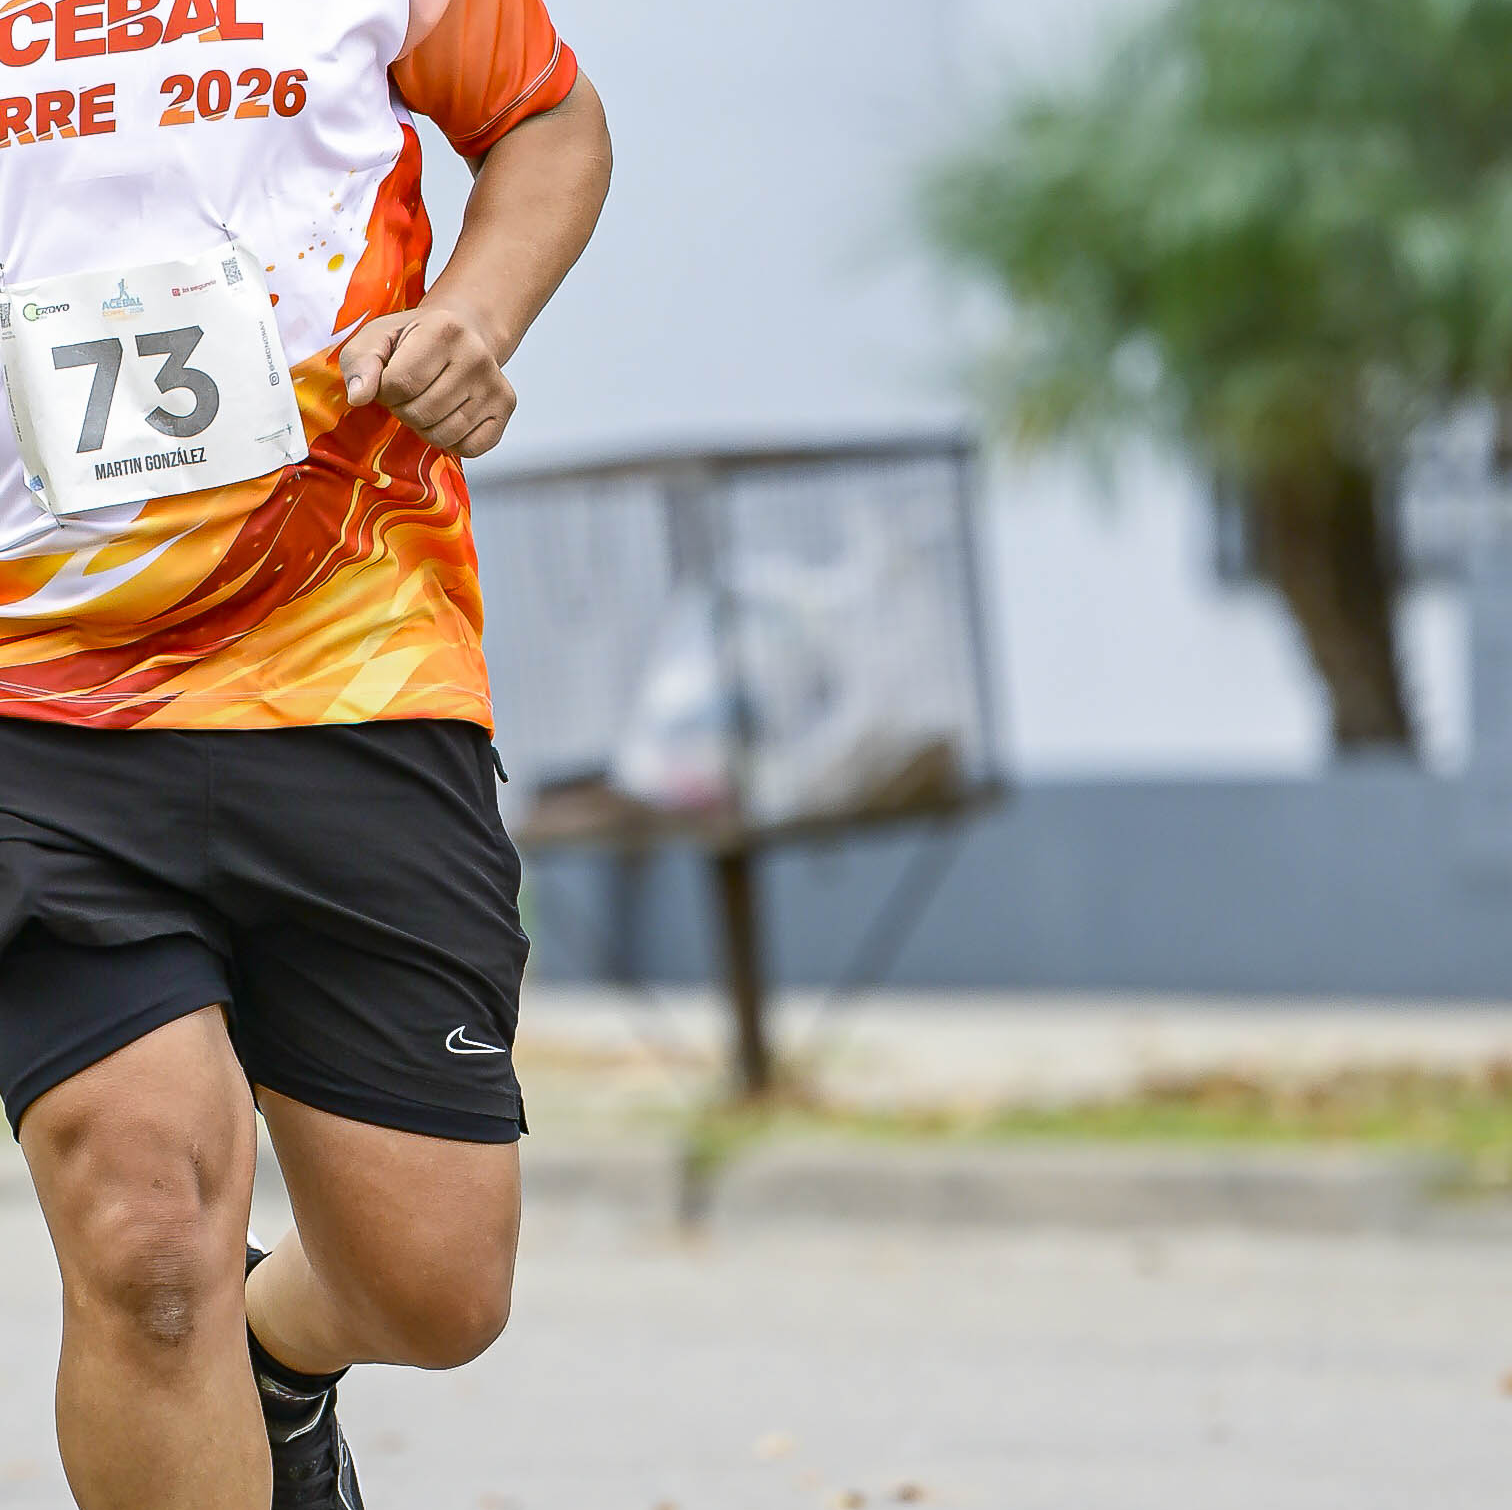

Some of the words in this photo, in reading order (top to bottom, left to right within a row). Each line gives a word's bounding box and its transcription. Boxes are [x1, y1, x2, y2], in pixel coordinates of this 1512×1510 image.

[159, 68, 308, 127] 2026
[51, 325, 220, 454] 73
[94, 457, 143, 481] MARTIN
[145, 446, 207, 471] GONZÁLEZ
